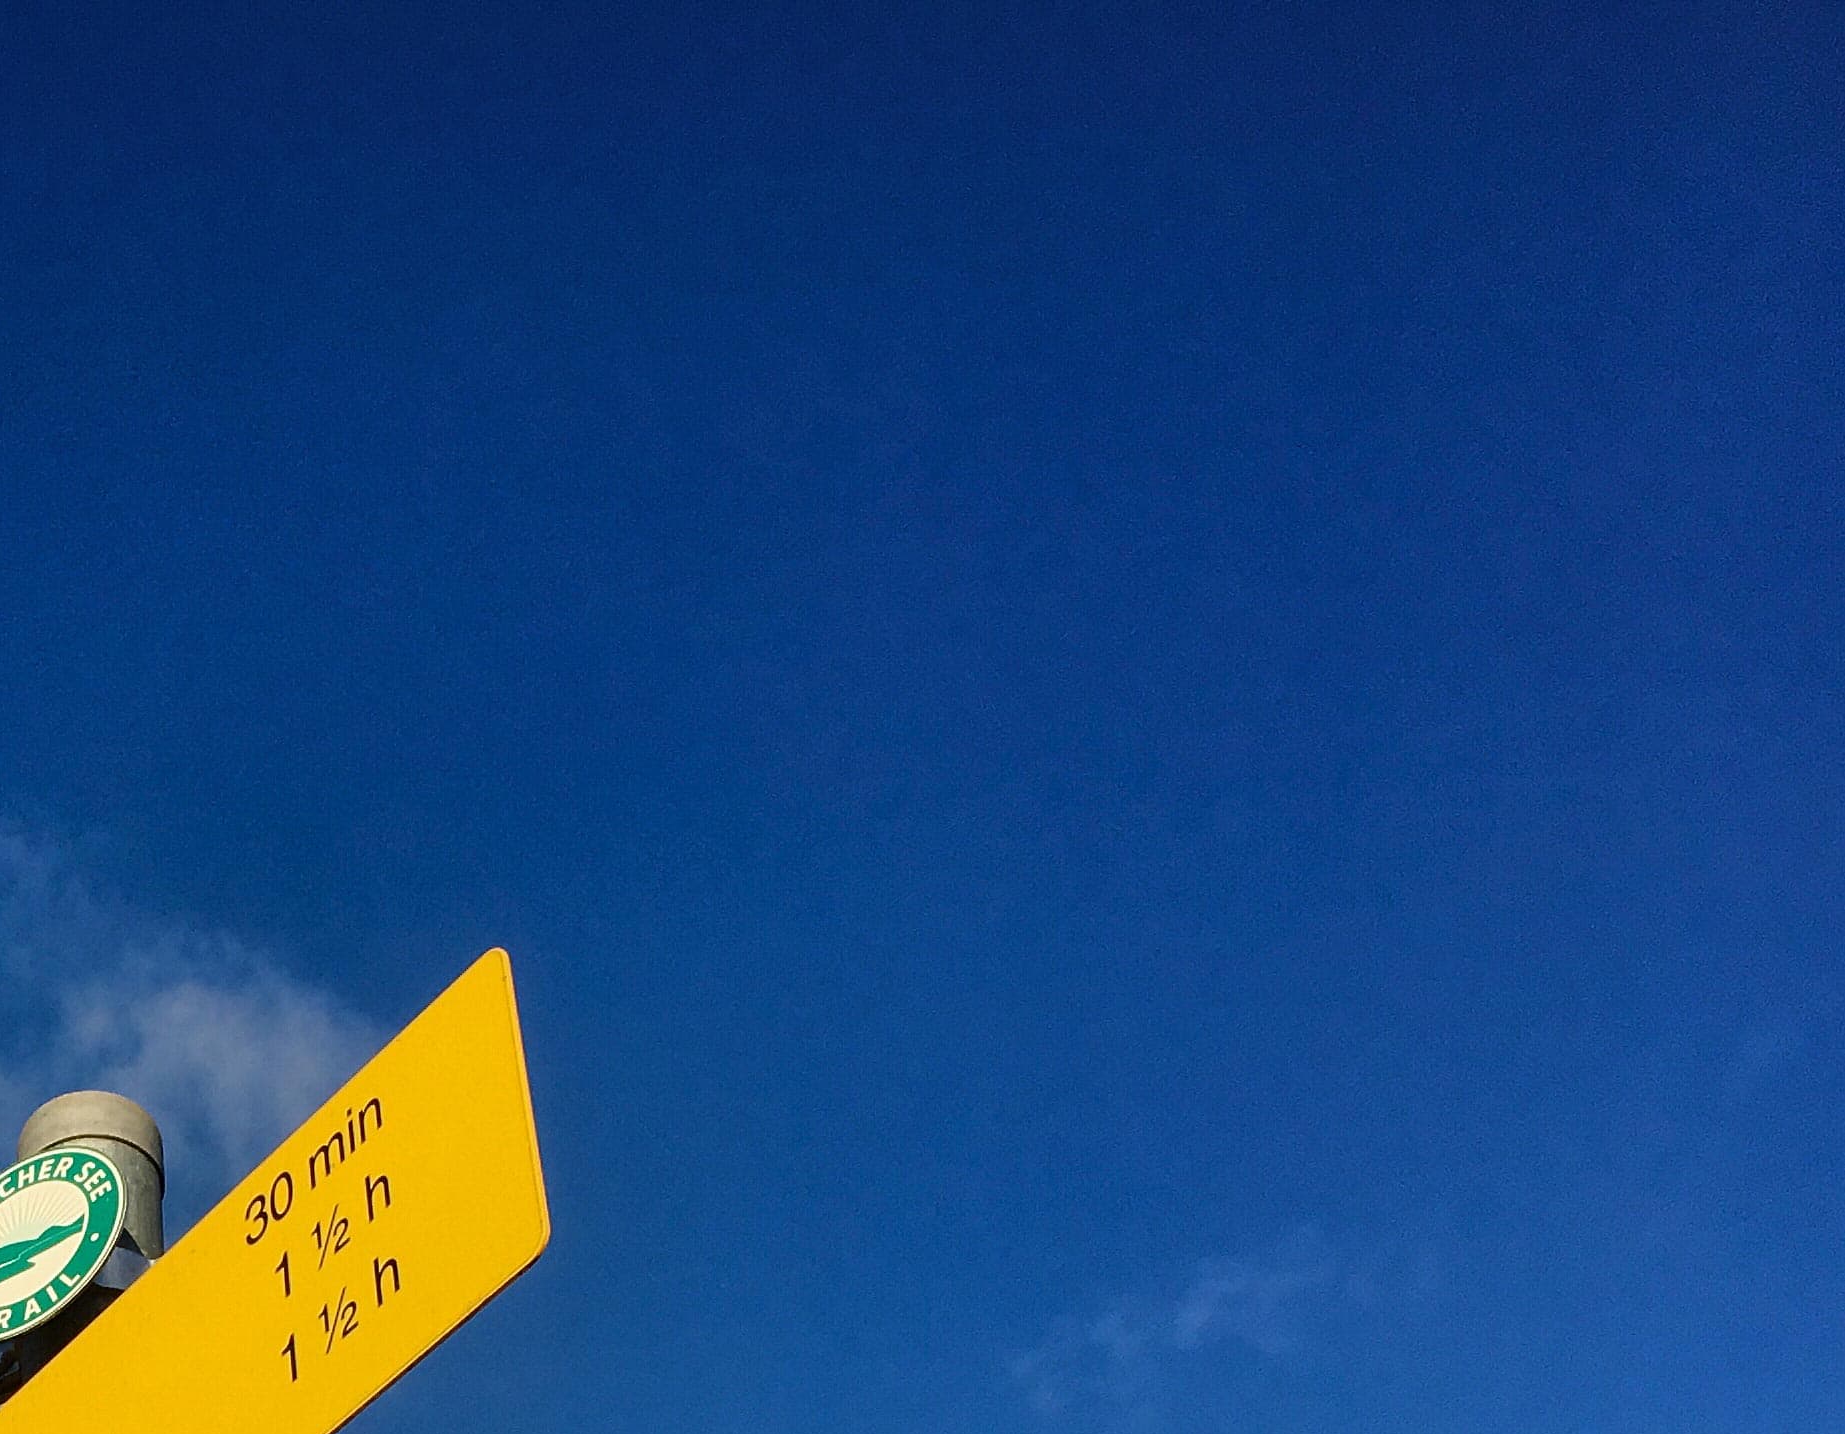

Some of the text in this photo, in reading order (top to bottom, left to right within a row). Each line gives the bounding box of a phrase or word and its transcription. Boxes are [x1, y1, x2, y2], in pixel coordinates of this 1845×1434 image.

[74, 1161, 112, 1203] SEE
[245, 1098, 382, 1245] 30 min
[275, 1251, 291, 1297] 1
[364, 1175, 391, 1222] h
[281, 1334, 298, 1382] 1
[373, 1257, 400, 1307] h
